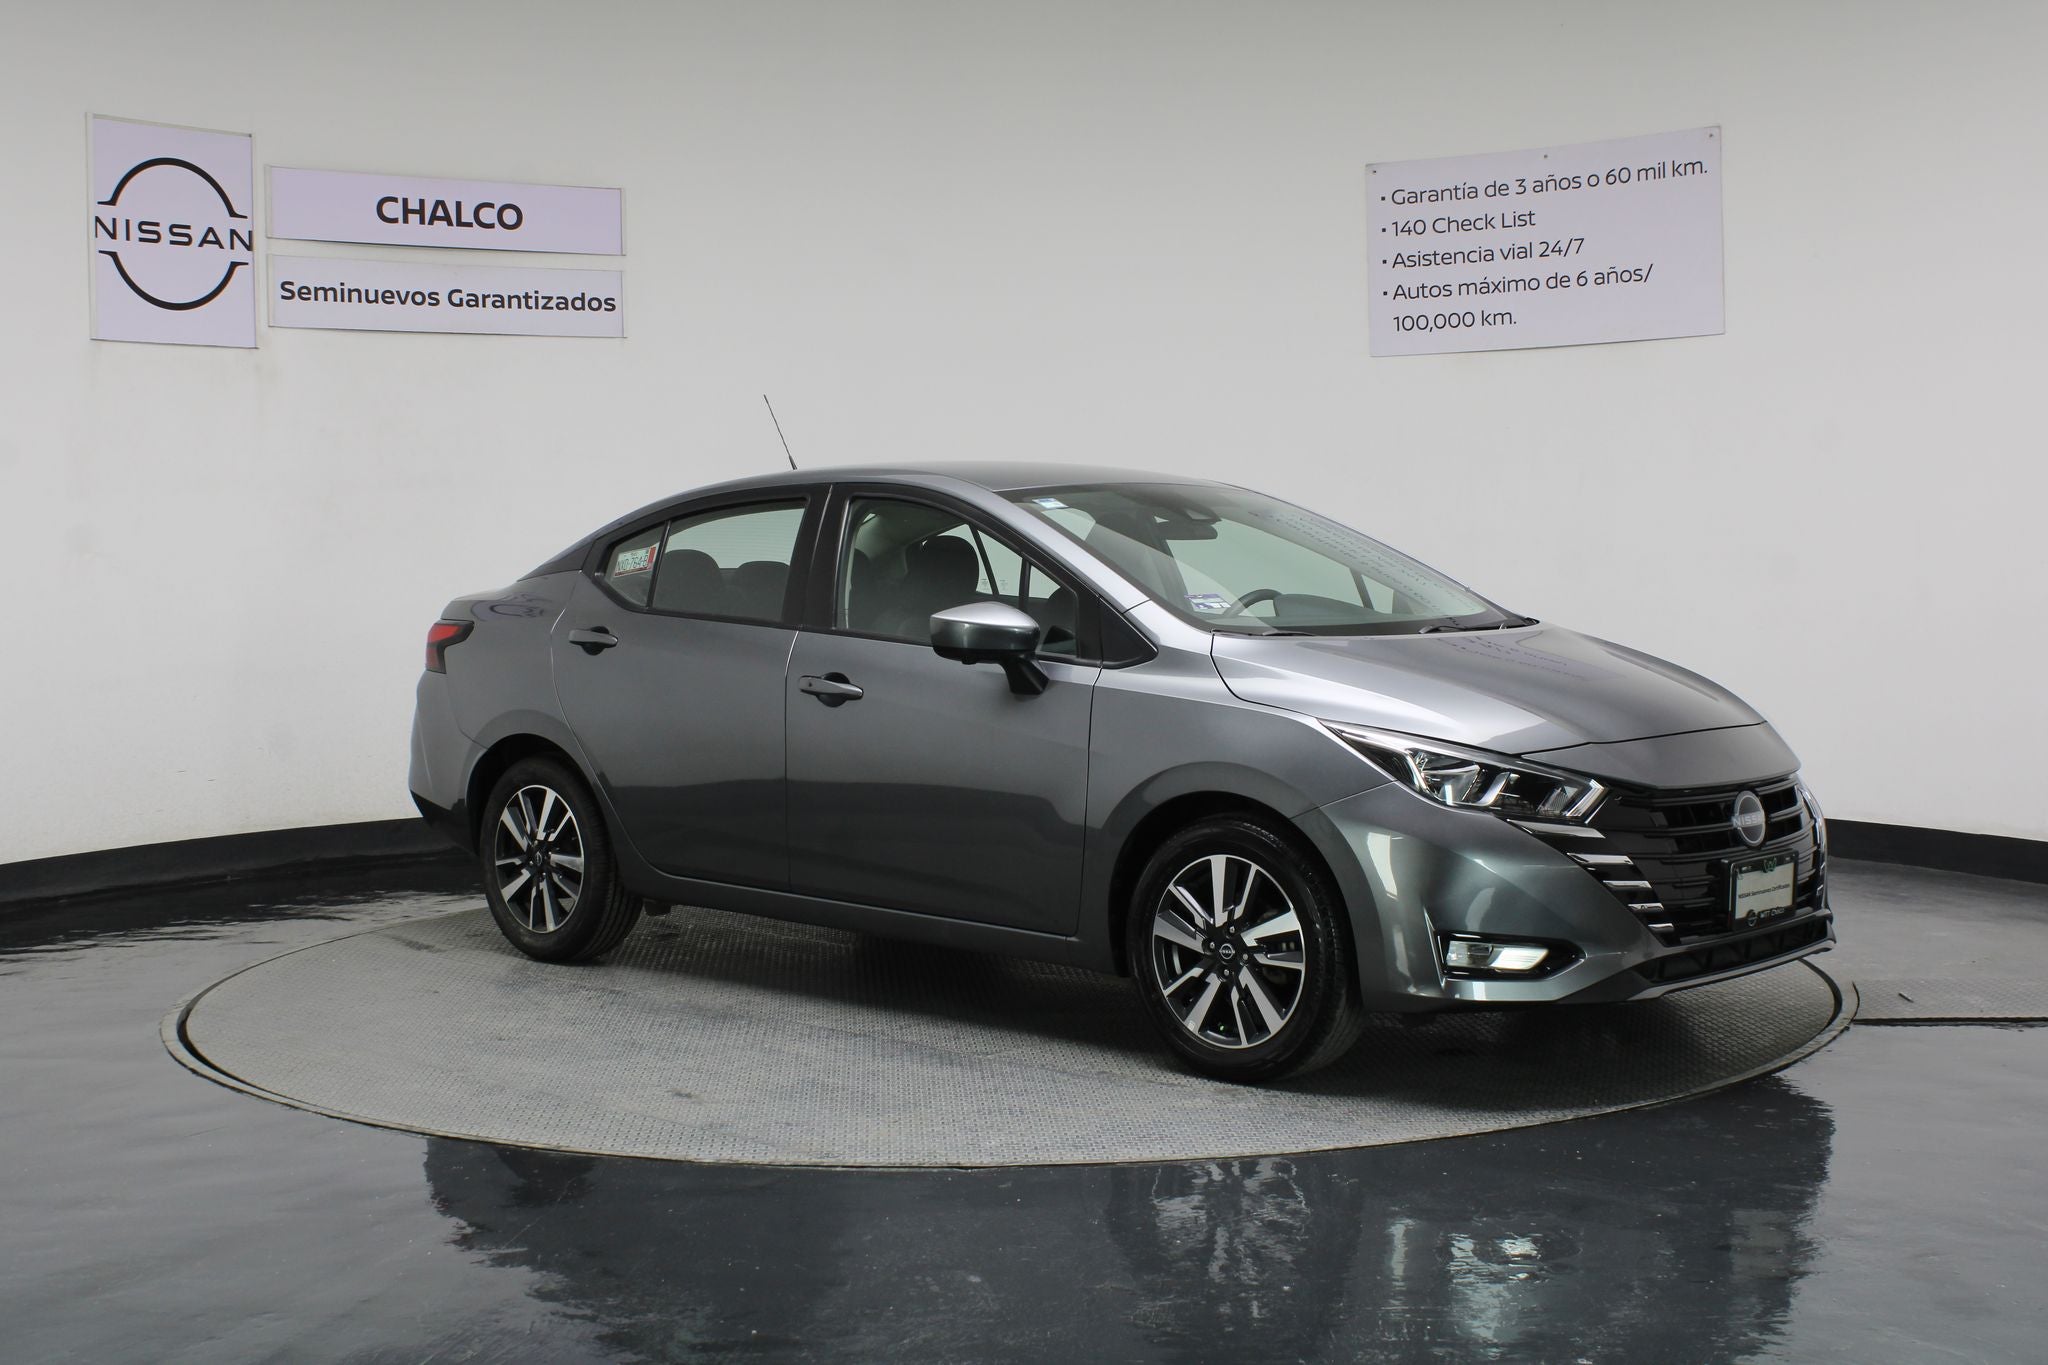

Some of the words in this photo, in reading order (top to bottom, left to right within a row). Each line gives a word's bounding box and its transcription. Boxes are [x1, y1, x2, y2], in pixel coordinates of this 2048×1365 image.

[1392, 182, 1478, 205] Garantía
[1485, 181, 1509, 197] de
[1515, 179, 1526, 195] 3
[1533, 174, 1581, 193] años
[1587, 174, 1599, 187] o
[1606, 167, 1631, 185] 60
[1637, 162, 1665, 181] mil
[1672, 160, 1707, 177] km.
[376, 196, 523, 230] CHALCO
[1392, 220, 1426, 236] 140
[1432, 213, 1495, 233] Check
[1502, 211, 1536, 228] List
[95, 215, 253, 251] NISSAN
[1392, 246, 1494, 268] Asistencia
[1500, 242, 1532, 260] vial
[1539, 238, 1584, 257] 24/7
[281, 281, 440, 306] Seminuevos
[448, 289, 616, 312] Garantizados
[1393, 283, 1452, 300] Autos
[1459, 276, 1540, 296] máximo
[1546, 272, 1570, 289] de
[1577, 271, 1588, 286] 6
[1594, 264, 1653, 285] años/
[1393, 312, 1475, 332] 100,000
[1482, 310, 1516, 326] km.
[1733, 814, 1764, 828] NISS
